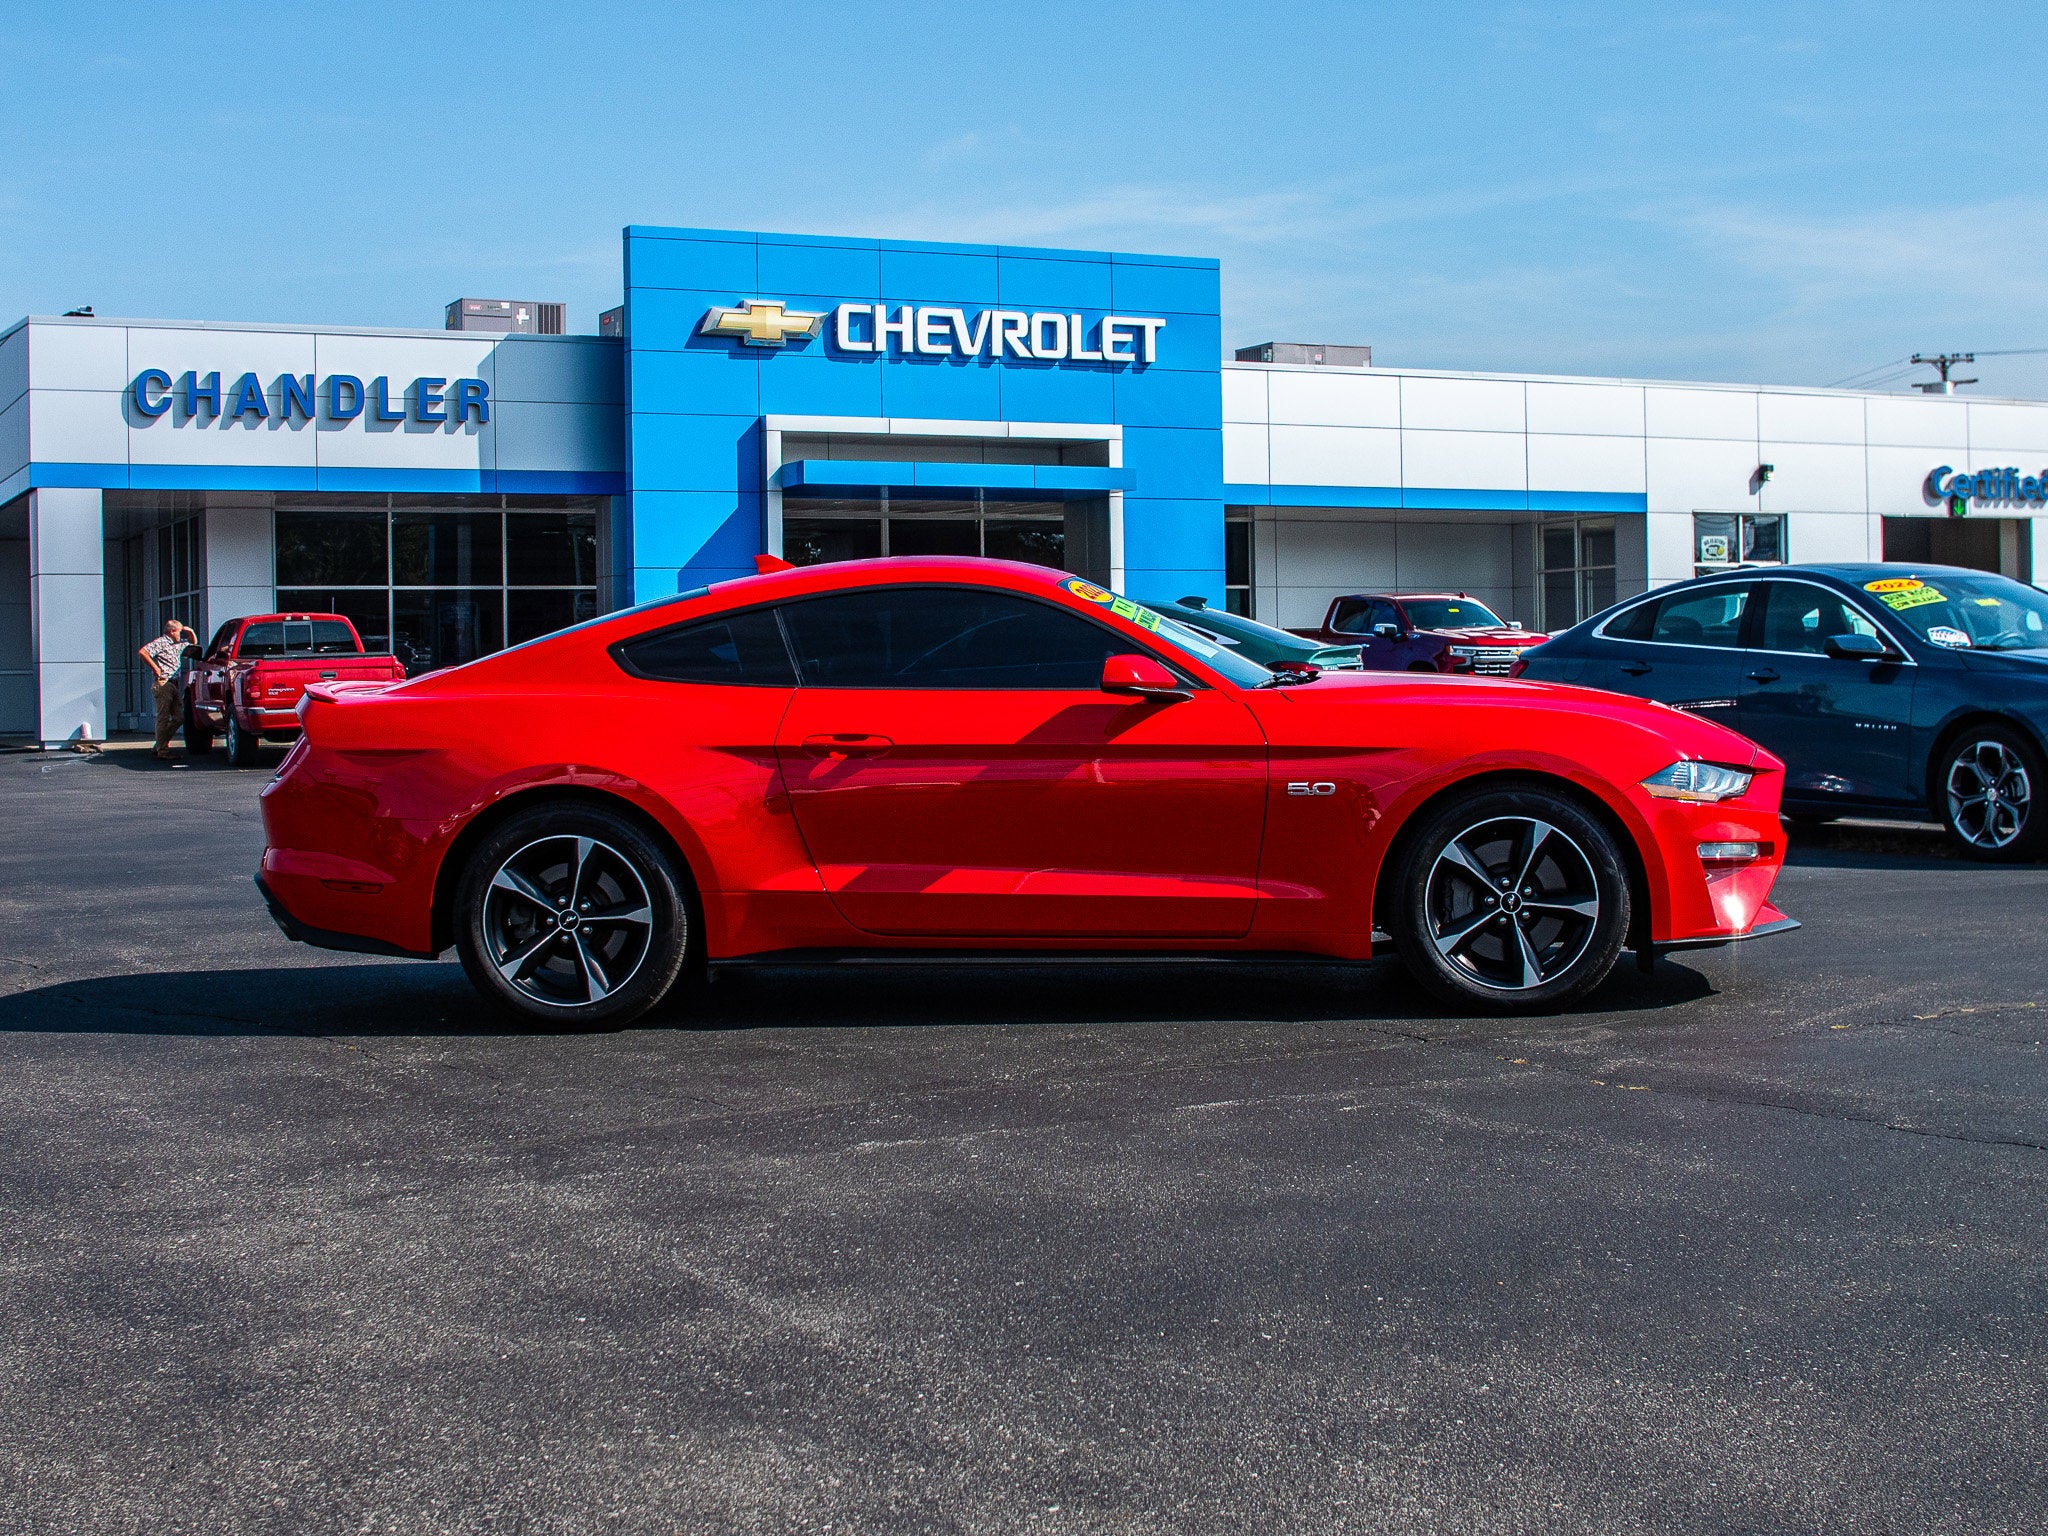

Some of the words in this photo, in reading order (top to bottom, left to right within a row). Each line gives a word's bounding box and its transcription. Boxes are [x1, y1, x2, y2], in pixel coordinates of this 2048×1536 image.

[837, 303, 1166, 362] CHEVROLET
[134, 368, 490, 423] CHANDLER
[1287, 782, 1336, 796] 5.0
